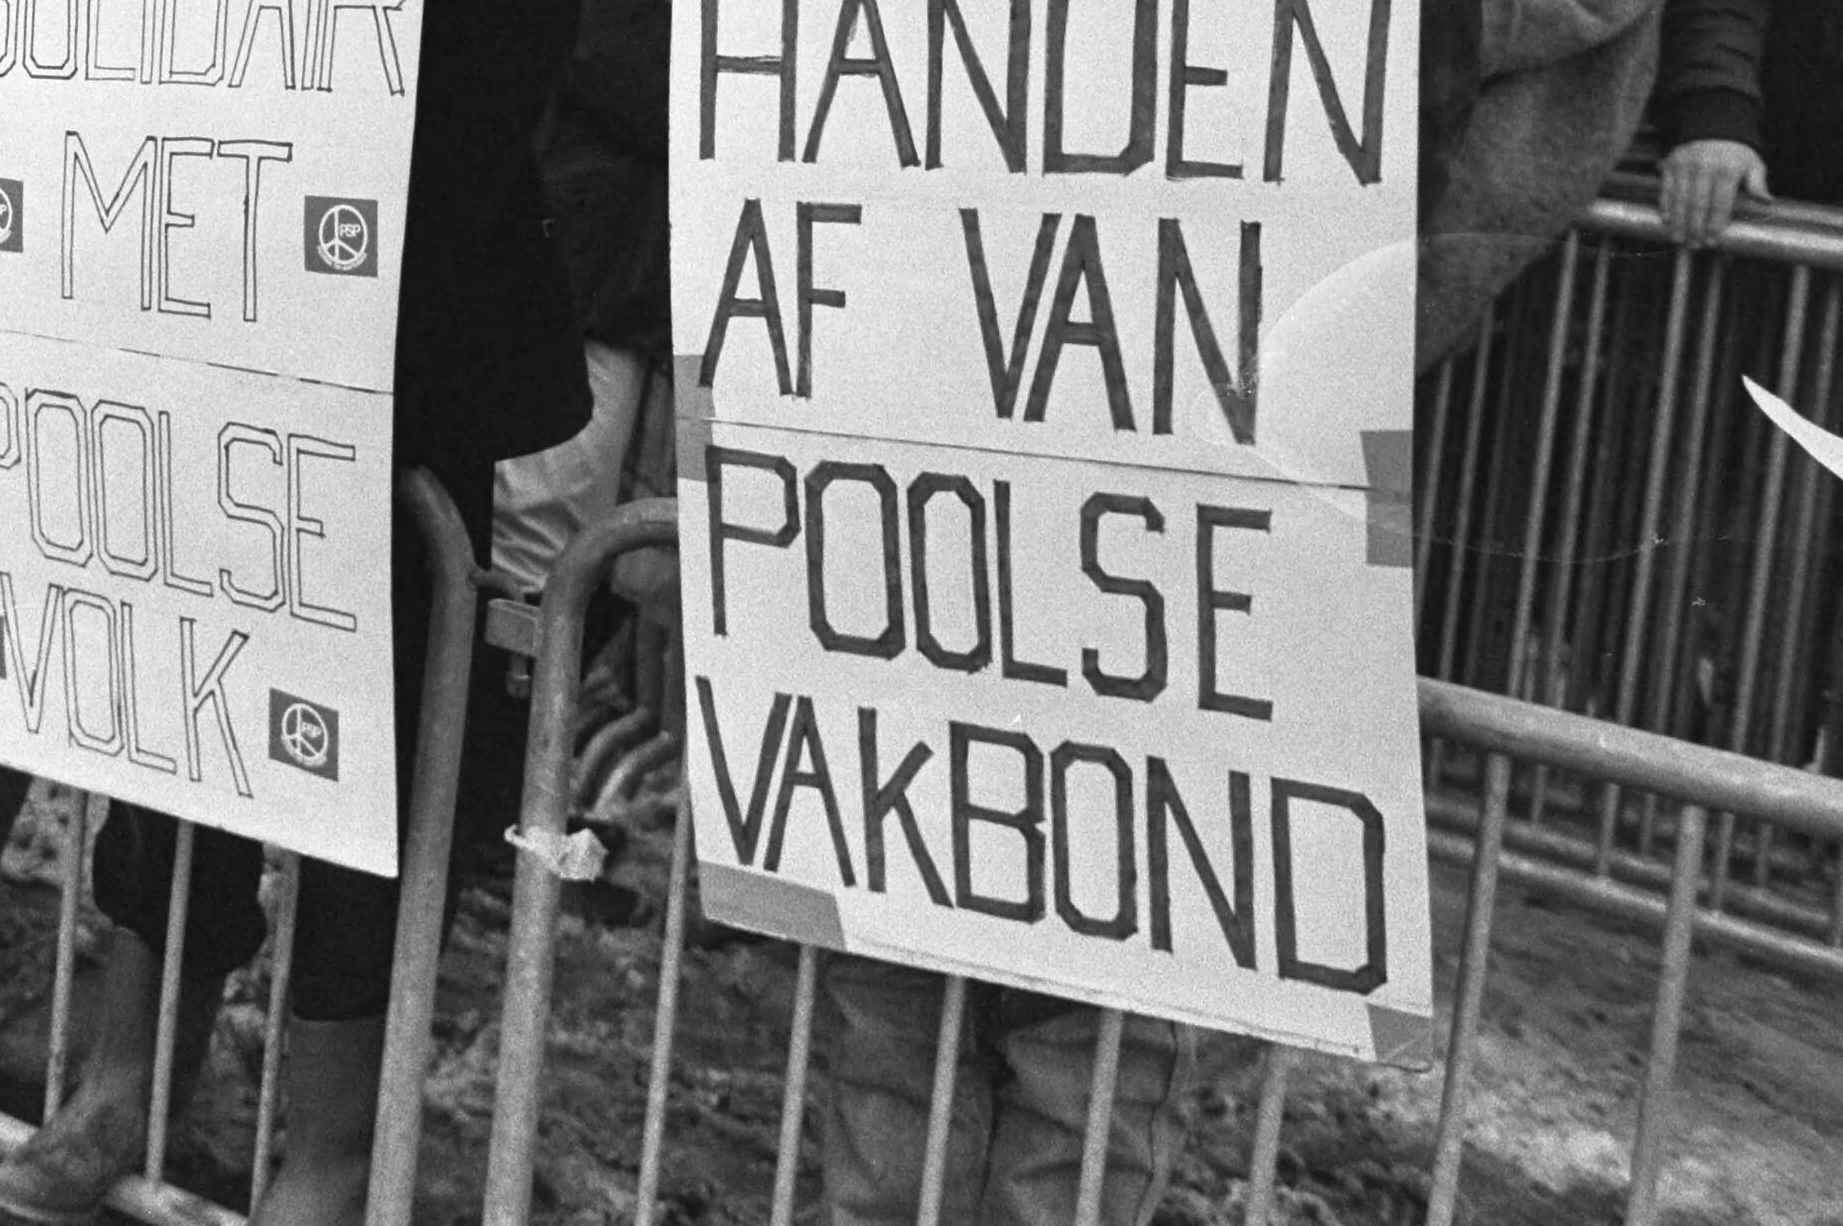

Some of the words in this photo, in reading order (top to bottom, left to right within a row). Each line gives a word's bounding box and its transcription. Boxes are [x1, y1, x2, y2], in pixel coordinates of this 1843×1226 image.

[62, 130, 293, 322] MET
[700, 199, 862, 399] AF
[958, 207, 1262, 445] VAN
[0, 571, 252, 799] VOLK
[705, 445, 1275, 721] POOLSE
[696, 676, 1387, 994] VAKBOND
